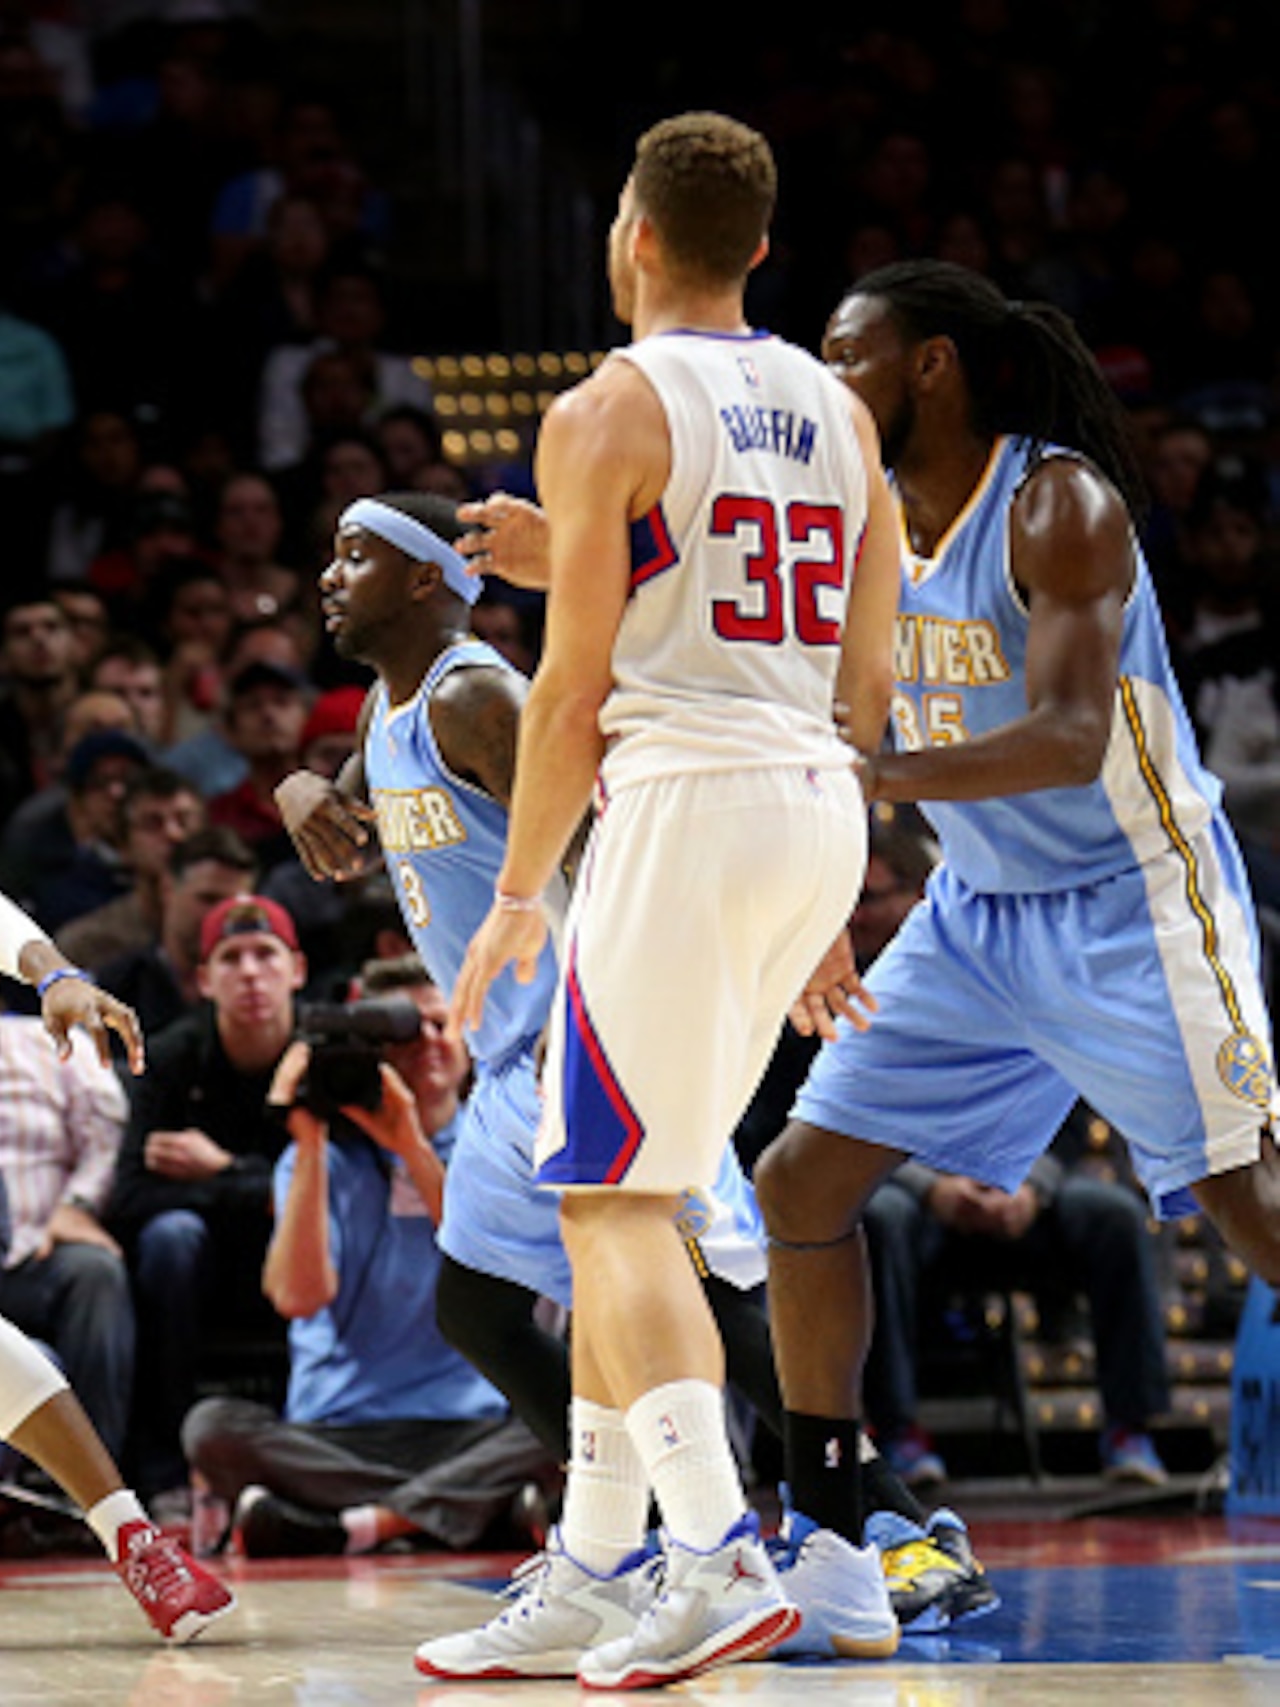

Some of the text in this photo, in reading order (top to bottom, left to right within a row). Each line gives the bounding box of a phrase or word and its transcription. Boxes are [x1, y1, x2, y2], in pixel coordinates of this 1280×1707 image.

[709, 493, 844, 645] 32
[891, 691, 971, 753] 35
[397, 860, 432, 928] 3
